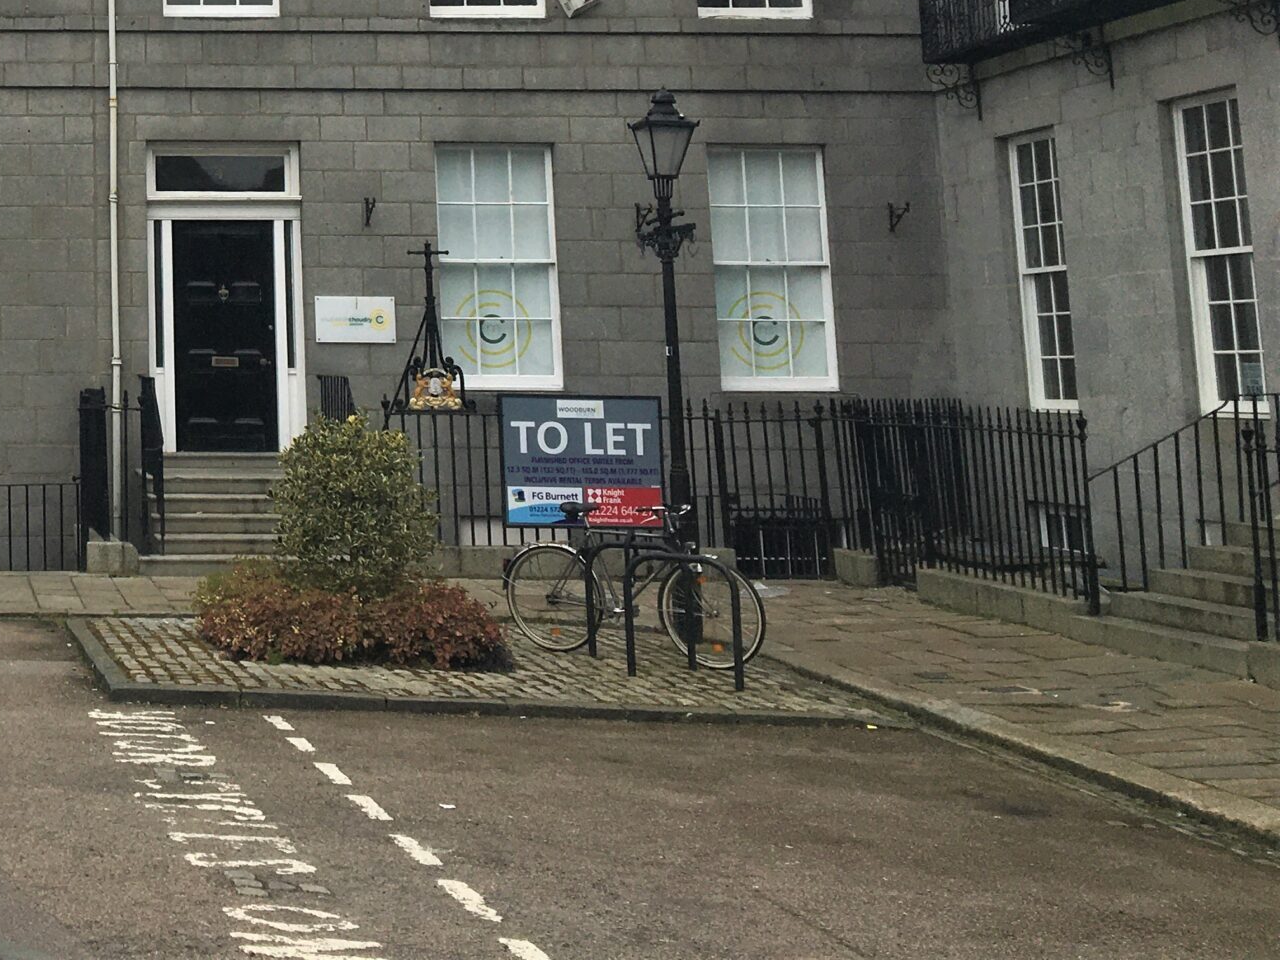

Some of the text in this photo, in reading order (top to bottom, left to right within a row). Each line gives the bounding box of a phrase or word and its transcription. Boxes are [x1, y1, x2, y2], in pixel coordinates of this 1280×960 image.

[510, 421, 651, 456] TO LET
[532, 491, 579, 501] FG Burnett
[602, 488, 625, 497] Knight
